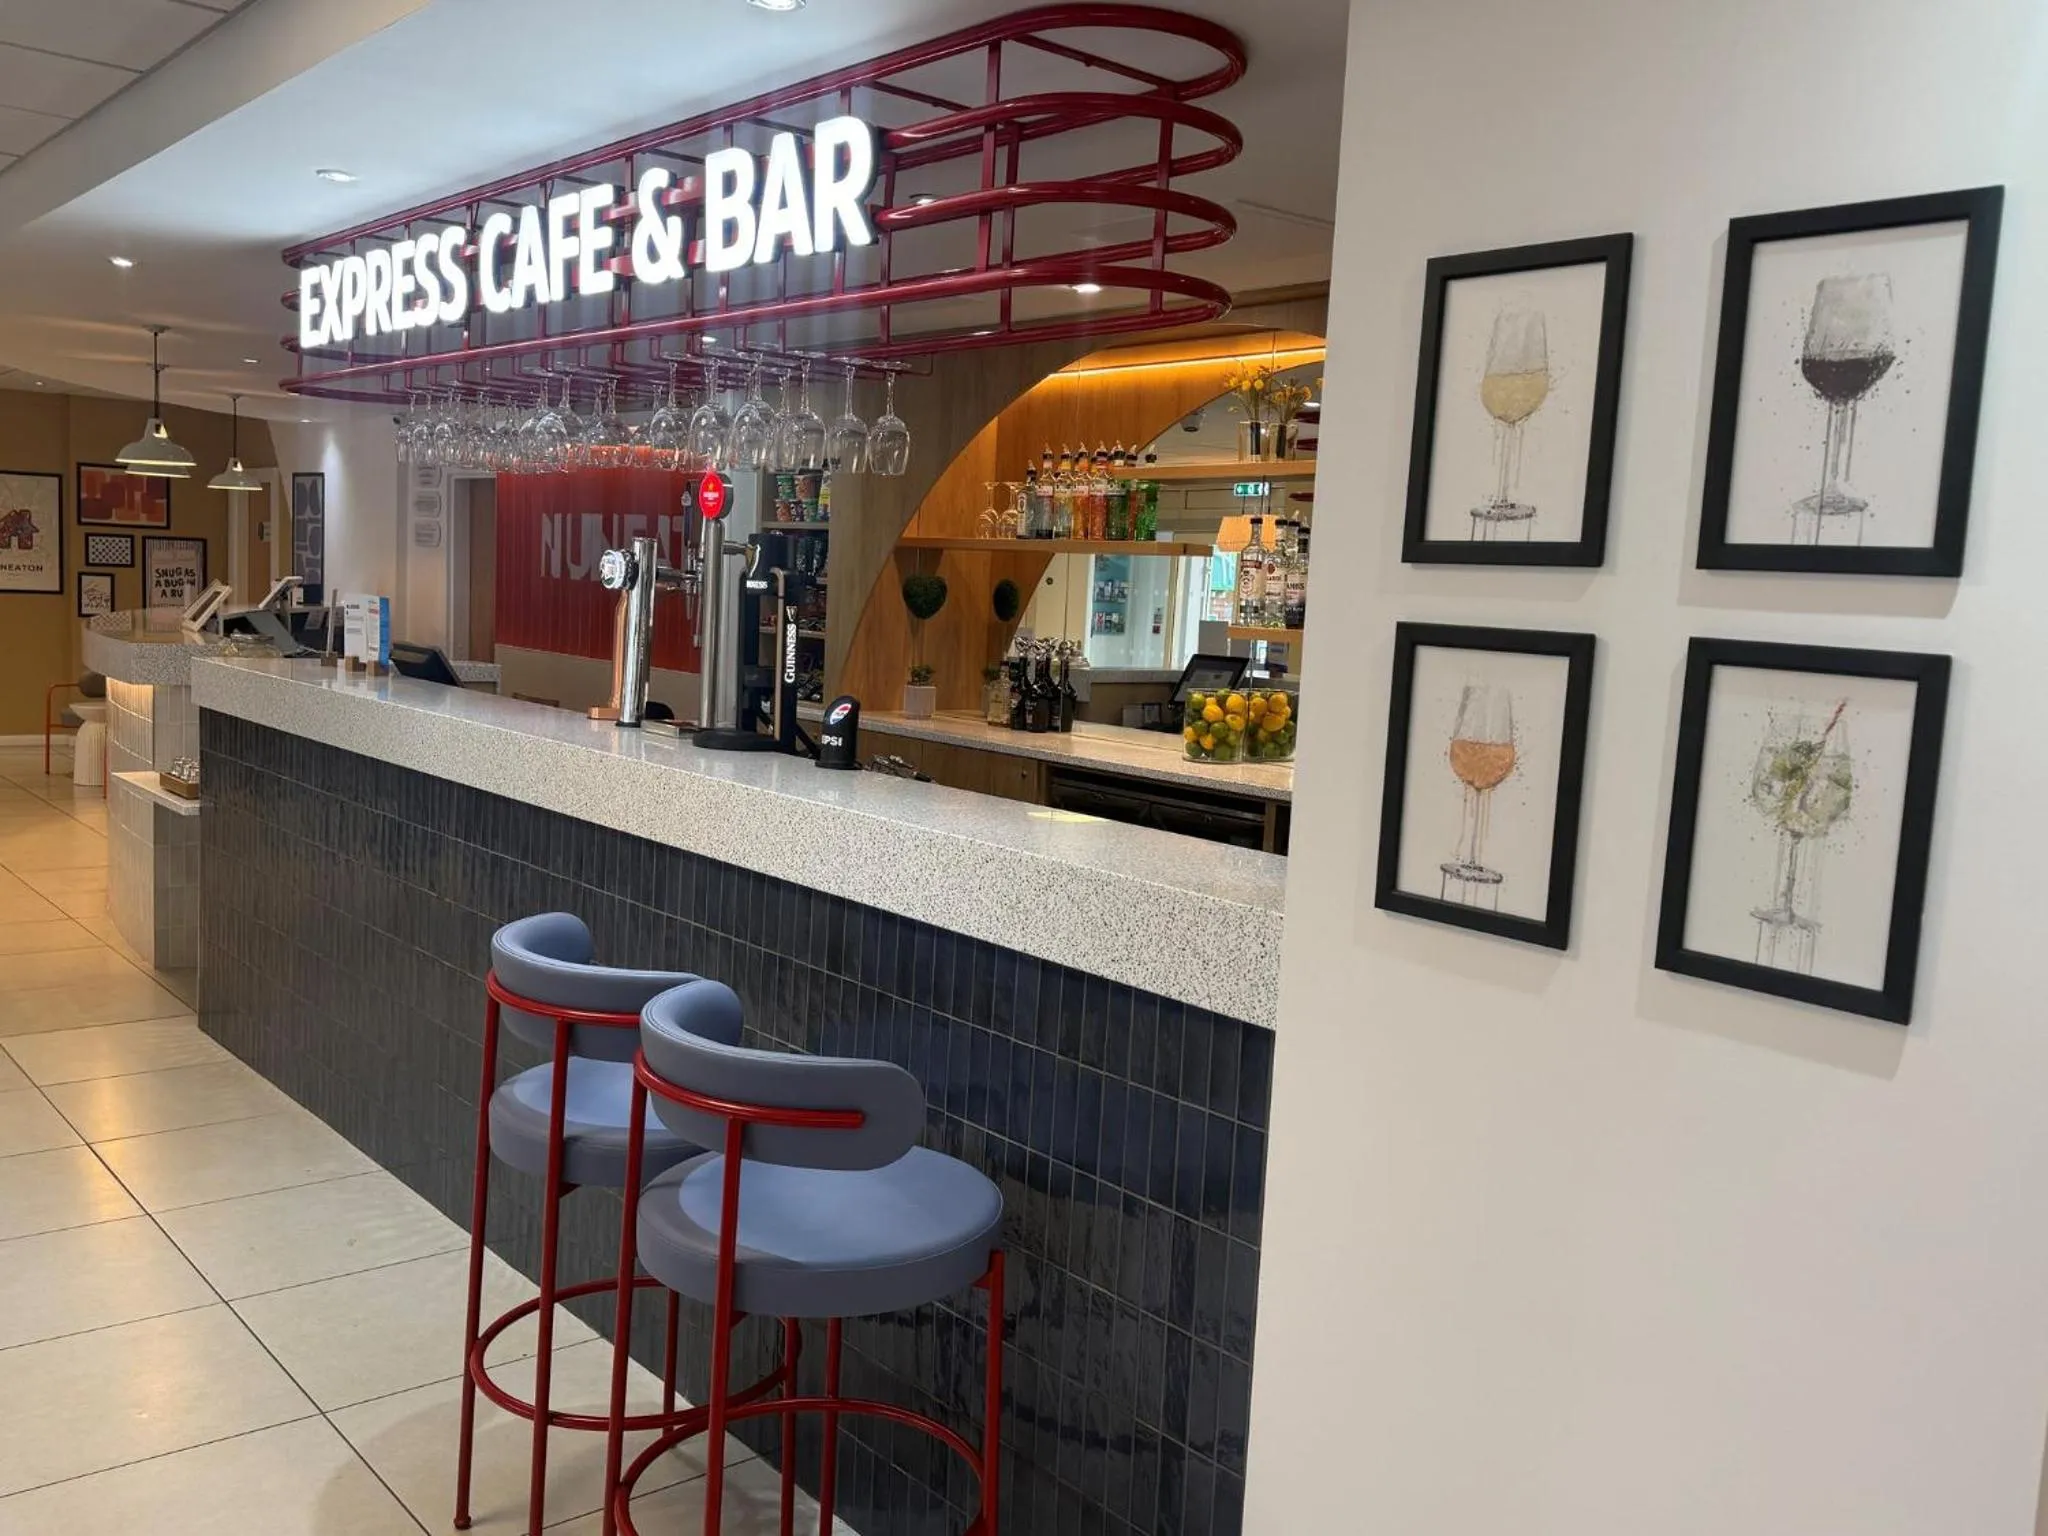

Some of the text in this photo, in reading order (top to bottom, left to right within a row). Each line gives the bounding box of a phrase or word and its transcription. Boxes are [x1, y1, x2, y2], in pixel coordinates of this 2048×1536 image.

[299, 115, 874, 349] EXPRESS CAFE & BAR
[540, 513, 688, 582] NUNEAT
[154, 566, 196, 578] SNUG AS
[155, 579, 162, 588] A
[164, 577, 184, 588] BUG
[160, 588, 184, 598] A RU
[784, 623, 797, 684] GUINNESS
